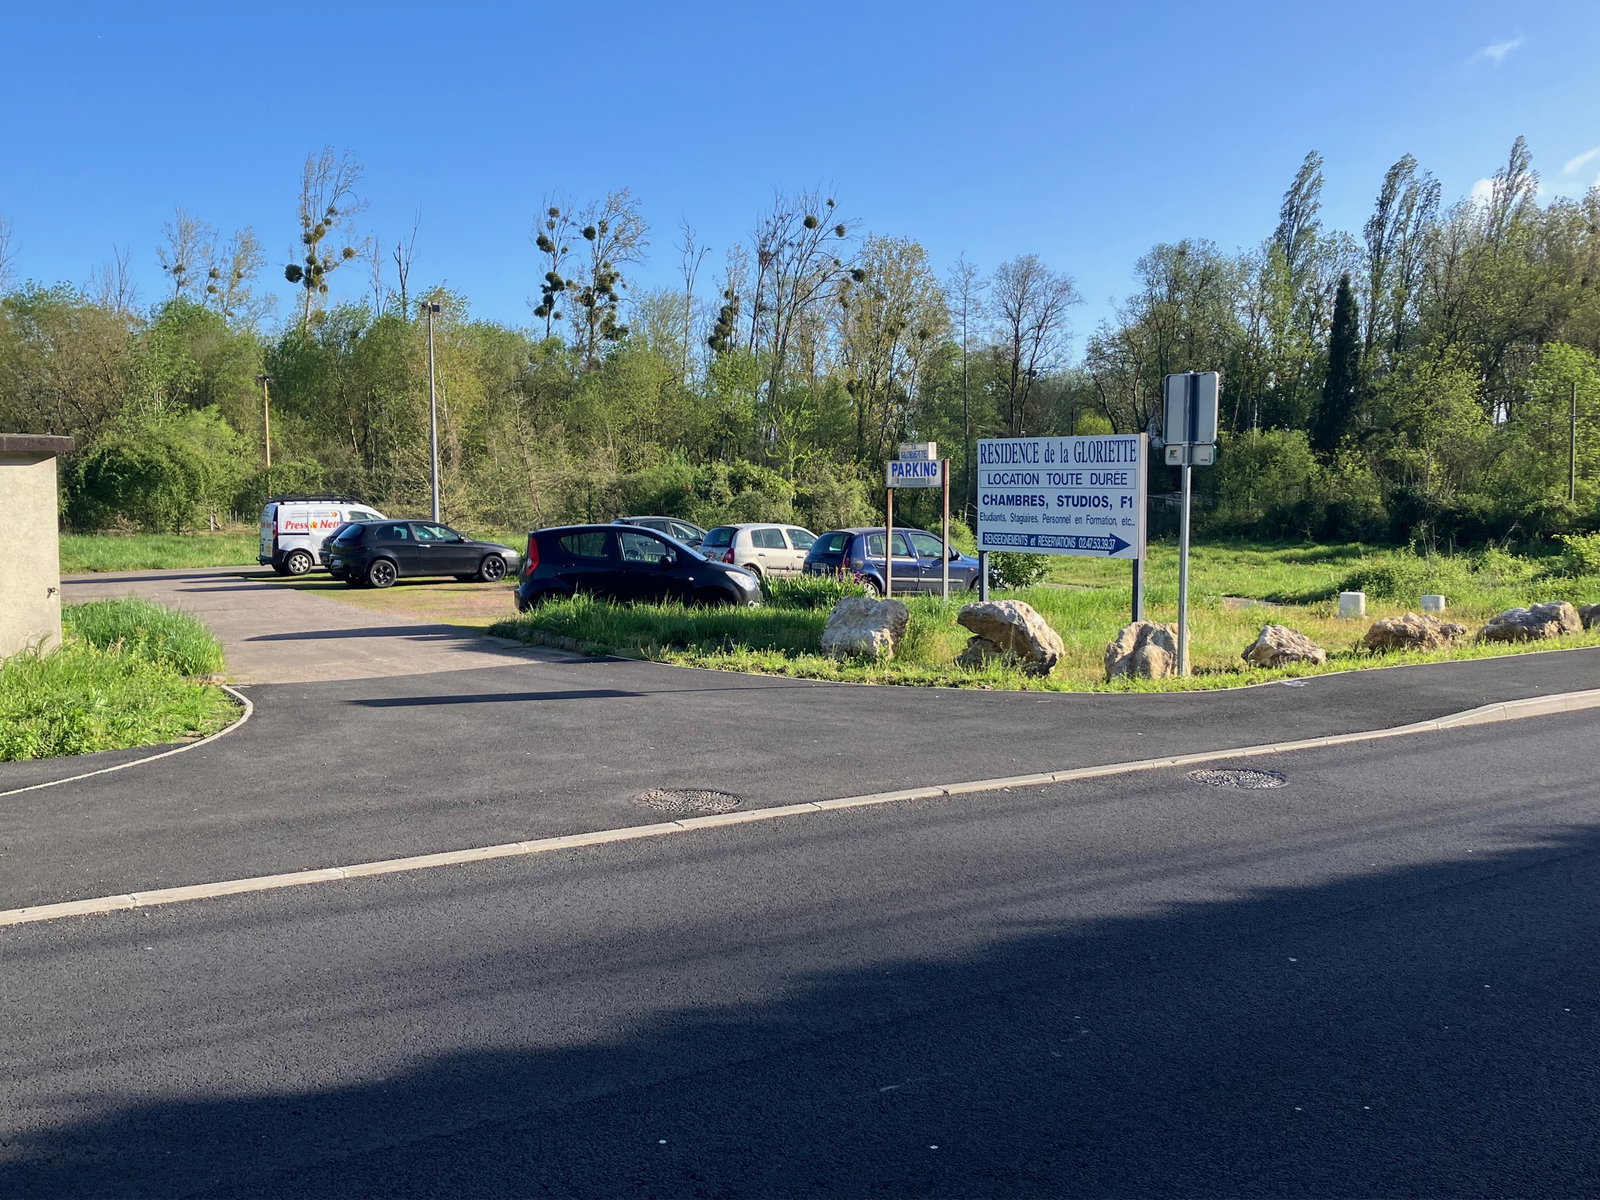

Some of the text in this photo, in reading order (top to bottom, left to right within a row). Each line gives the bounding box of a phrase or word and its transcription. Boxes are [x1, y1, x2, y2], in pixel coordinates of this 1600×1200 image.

[1044, 441, 1055, 463] de
[1060, 441, 1069, 463] la
[1073, 440, 1136, 463] GLORIETTE
[891, 462, 937, 477] PARKING
[988, 471, 1128, 485] LOCATION TOUTE DURÉE
[982, 494, 1133, 510] CHAMBRES, STUDIOS, F1
[285, 520, 309, 530] Press
[1042, 513, 1071, 524] Personnel
[1074, 516, 1082, 524] en
[1086, 514, 1118, 527] Formation,
[1030, 536, 1036, 546] et
